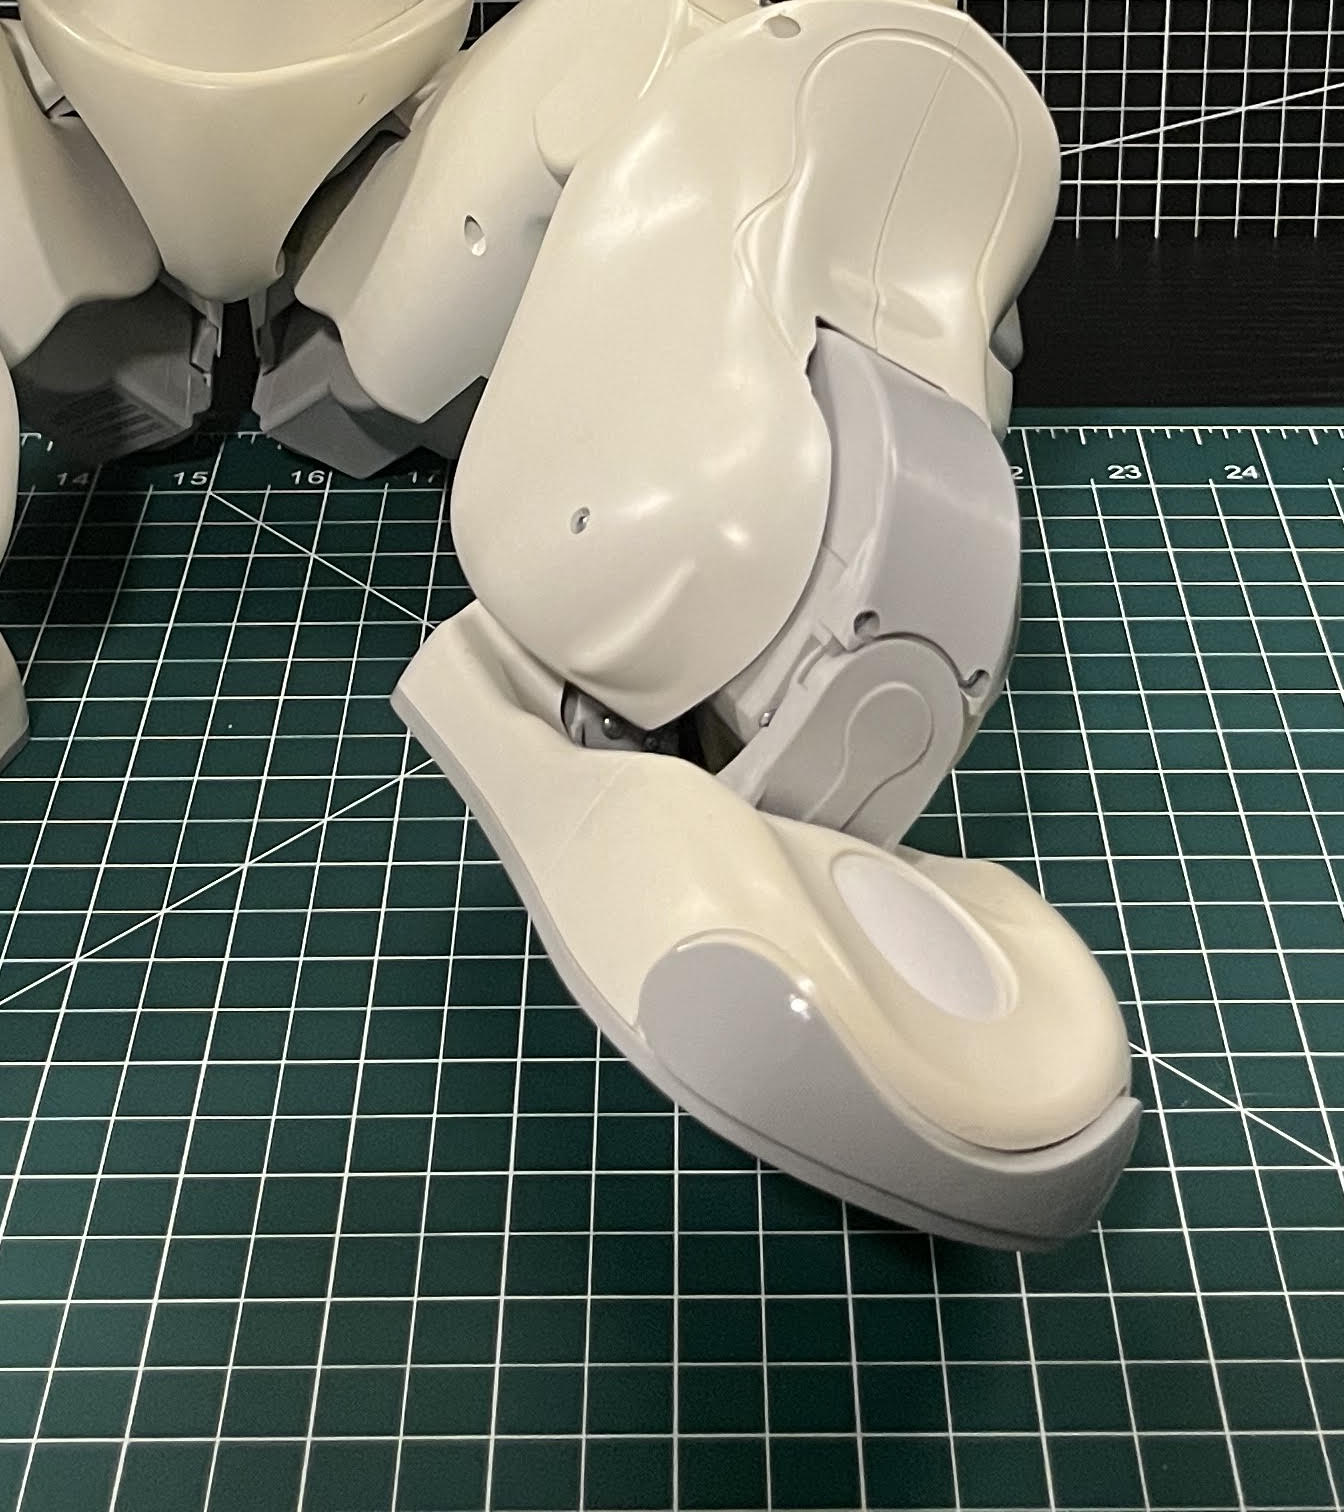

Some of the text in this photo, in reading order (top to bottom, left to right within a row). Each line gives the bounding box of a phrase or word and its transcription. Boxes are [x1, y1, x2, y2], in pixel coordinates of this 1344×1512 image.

[57, 472, 89, 486] 14
[173, 471, 210, 486] 15
[291, 469, 326, 485] 16
[1107, 465, 1143, 480] 23
[1224, 464, 1260, 480] 24
